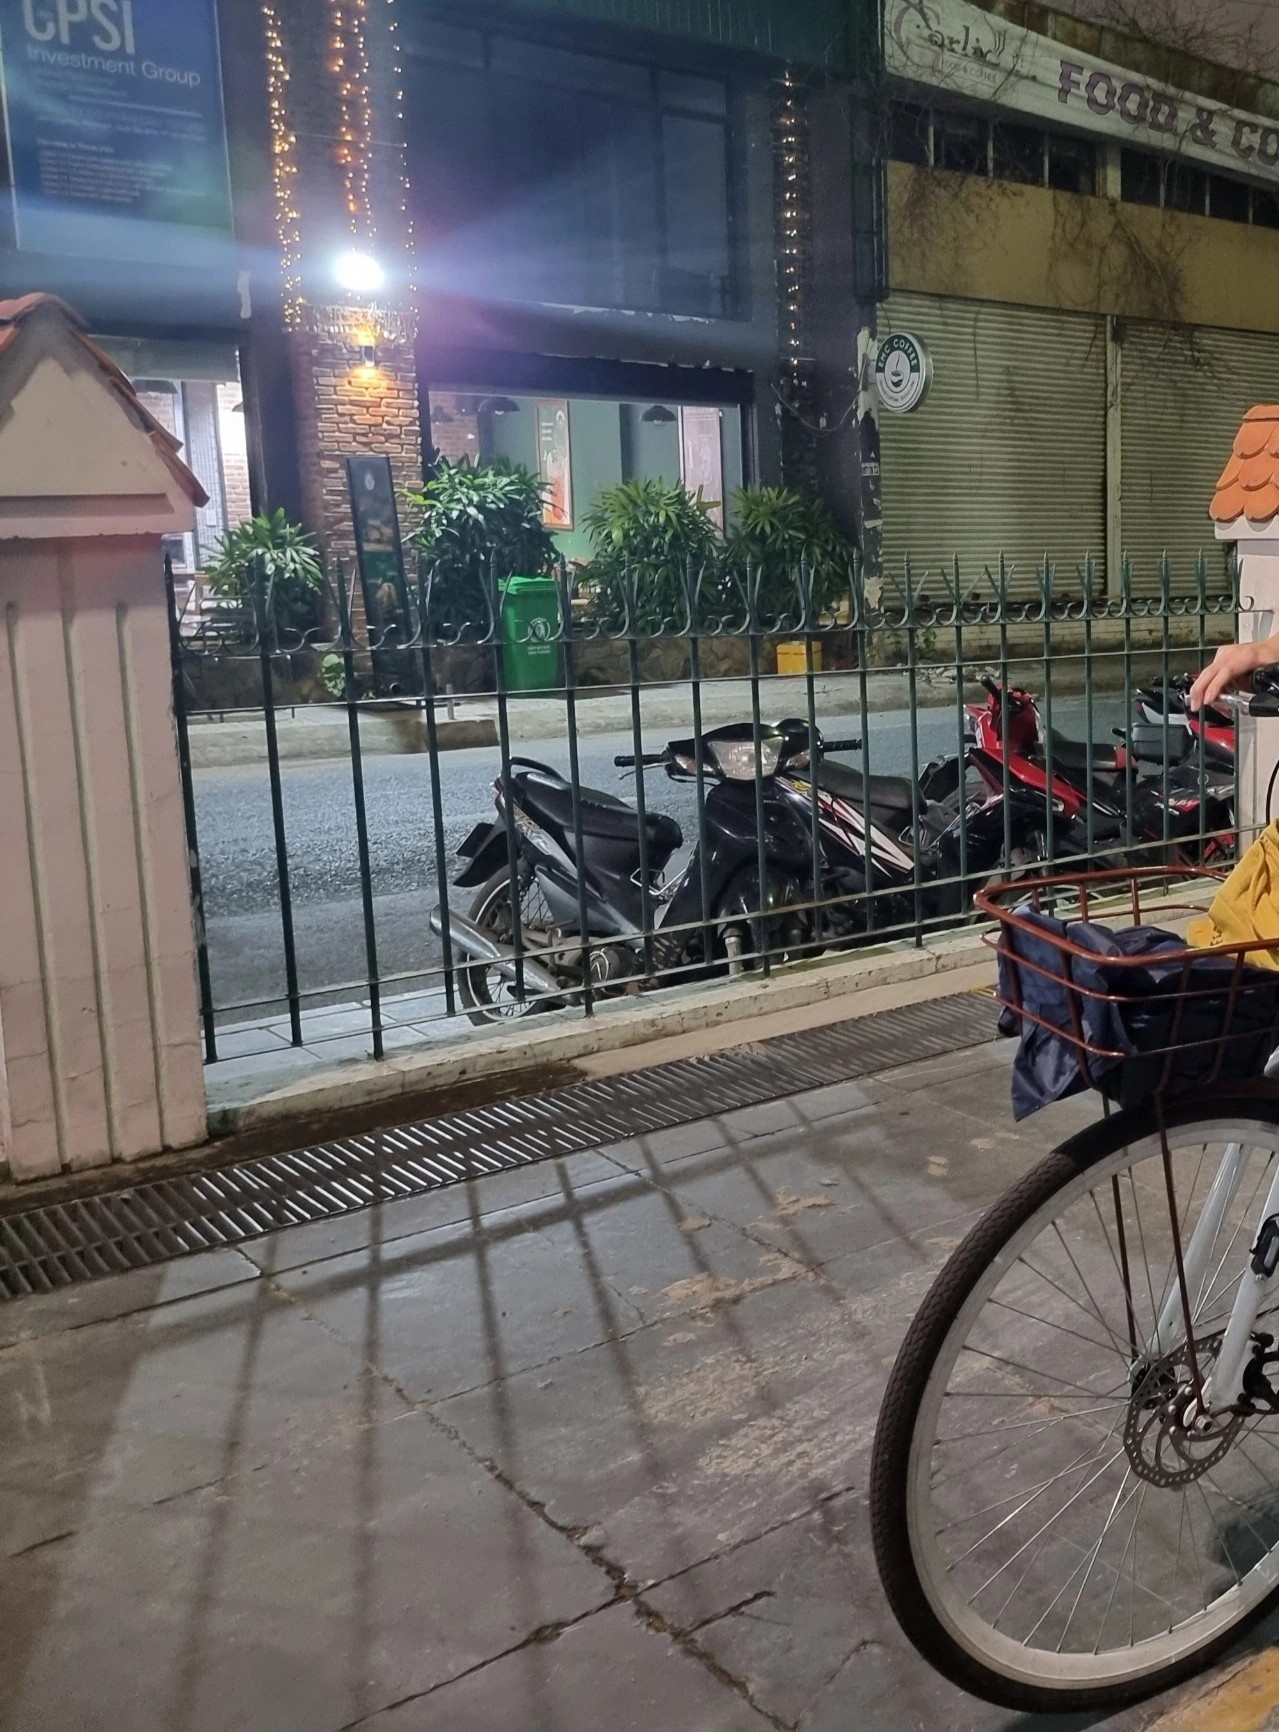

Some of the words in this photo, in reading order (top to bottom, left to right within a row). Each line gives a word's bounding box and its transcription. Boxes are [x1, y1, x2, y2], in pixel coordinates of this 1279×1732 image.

[27, 43, 136, 76] Investment
[141, 61, 200, 88] Group
[1057, 60, 1178, 133] FOOD
[1192, 109, 1217, 149] &
[893, 338, 918, 367] COFFEE
